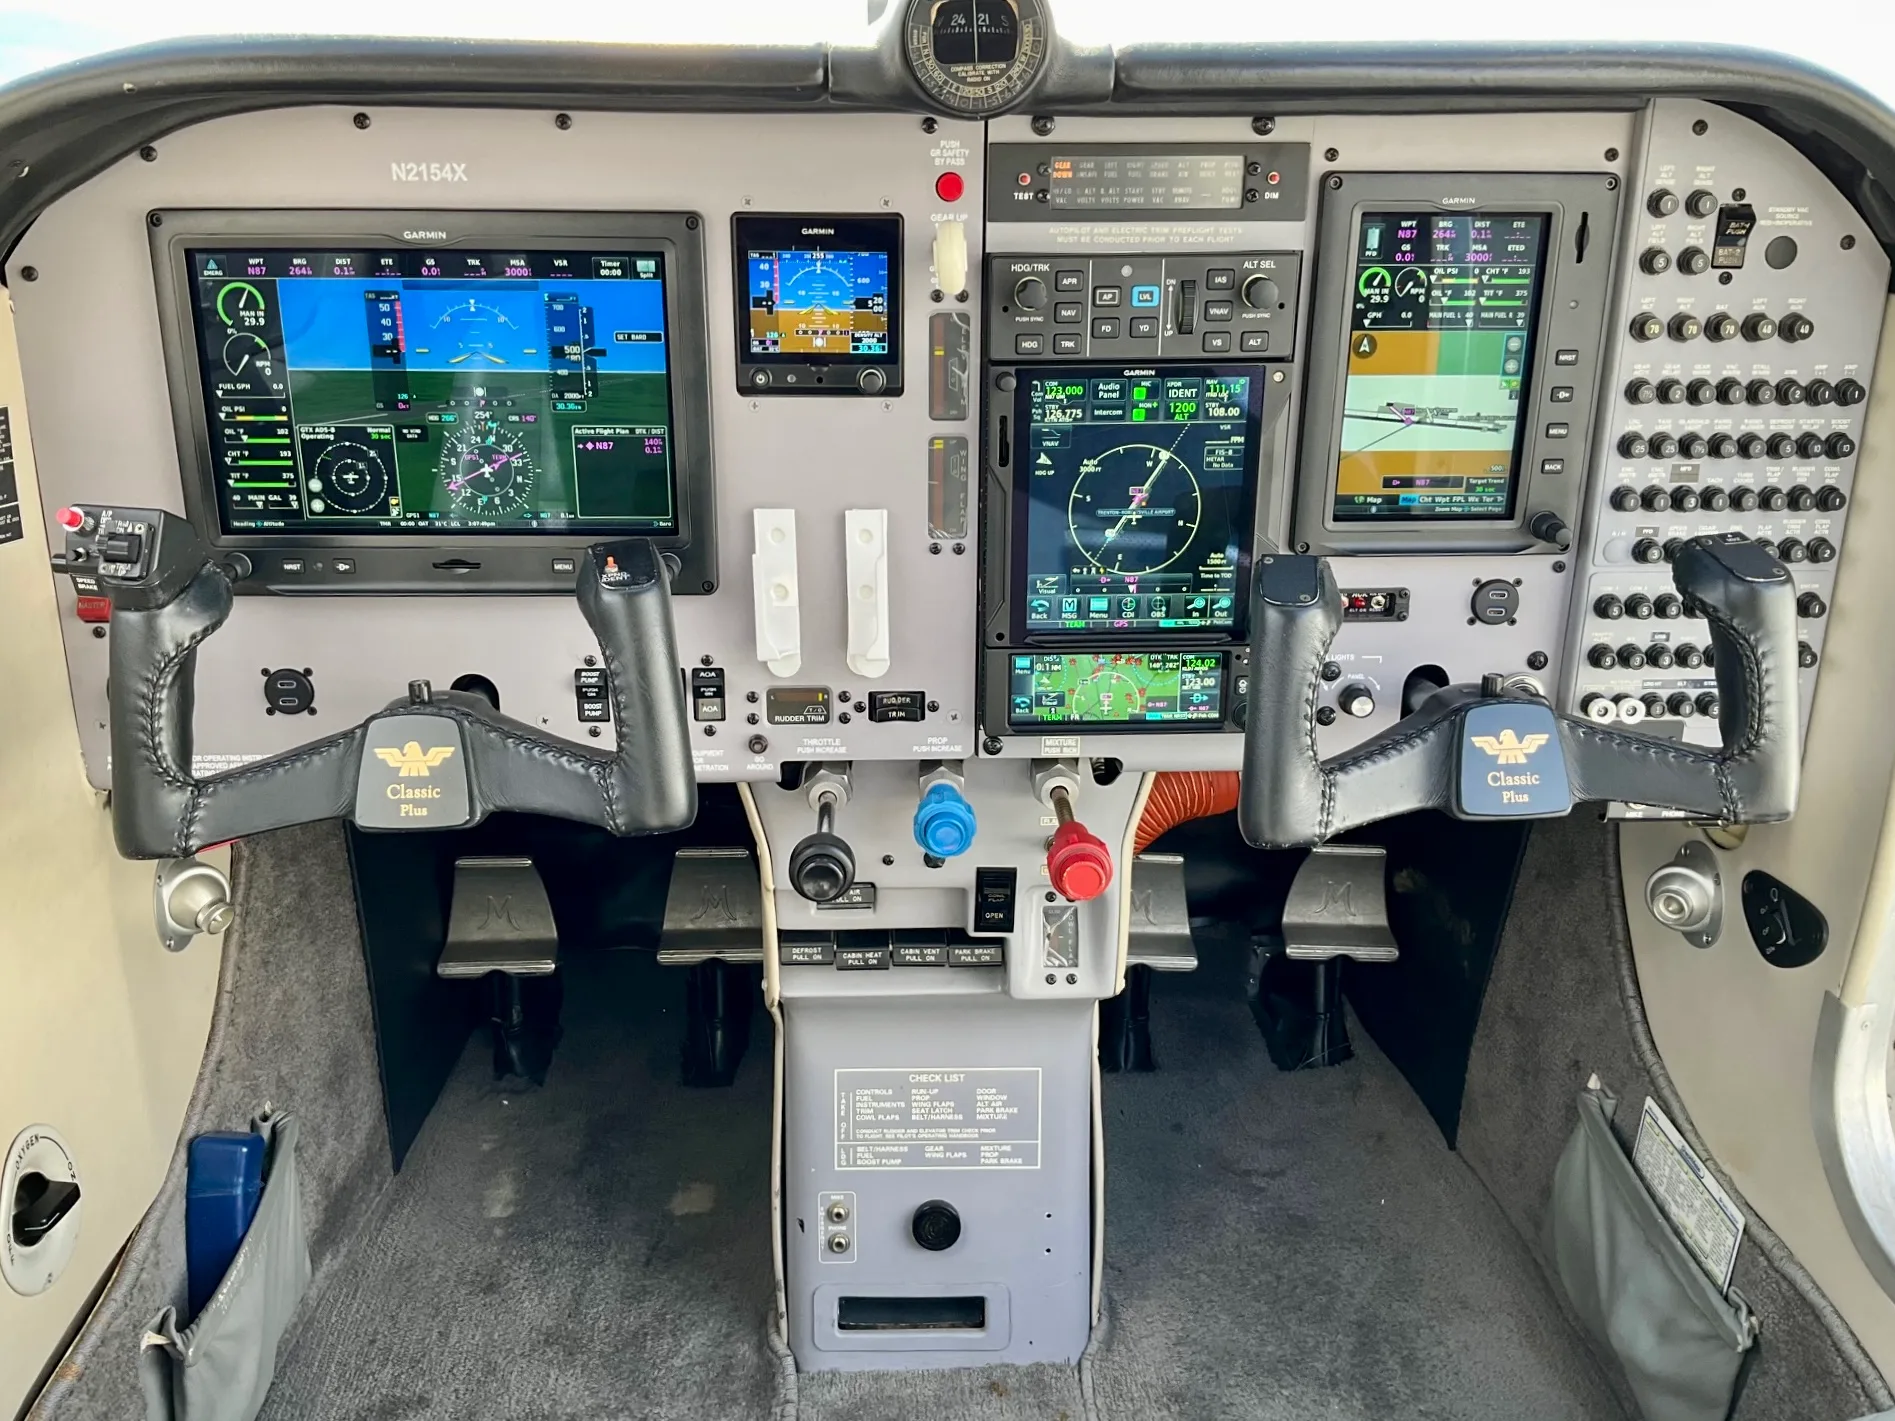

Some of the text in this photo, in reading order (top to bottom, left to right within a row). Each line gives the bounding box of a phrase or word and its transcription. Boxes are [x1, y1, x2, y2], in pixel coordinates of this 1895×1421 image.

[951, 13, 989, 26] 24 21
[939, 139, 961, 149] PUSH
[942, 148, 970, 157] SAFETY
[934, 157, 966, 166] BY PASS
[391, 161, 468, 182] N2154X
[1013, 192, 1279, 200] TEST DIM
[930, 213, 955, 222] GEAR
[403, 230, 447, 239] GARMIN
[1049, 227, 1091, 235] AUTOPILOT
[1093, 227, 1109, 235] AND
[1111, 227, 1148, 235] ELECTRIC
[1151, 227, 1170, 235] TRIM
[1173, 227, 1216, 235] PREFLIGHT
[1398, 230, 1417, 239] N87
[1182, 235, 1201, 243] EACH
[1203, 235, 1235, 243] FLIGHT
[1718, 248, 1740, 256] BAT-2
[601, 260, 621, 268] Timer
[1243, 260, 1276, 269] ALT SEL
[1718, 256, 1738, 264] PUSH
[247, 266, 266, 275] N87
[600, 268, 622, 277] 00:00
[1011, 264, 1050, 272] HDG/TRK
[1062, 277, 1077, 285] APR
[244, 318, 265, 326] 29.9
[1101, 325, 1111, 333] FD
[1139, 324, 1149, 332] YD
[1725, 324, 1734, 334] 70
[1762, 324, 1772, 333] 40
[1800, 324, 1810, 333] 40
[1248, 338, 1262, 346] ALT
[1046, 386, 1083, 396] 123.000
[1098, 382, 1120, 391] Audio
[1098, 390, 1120, 399] Panel
[1169, 389, 1197, 398] IDENT
[1169, 403, 1196, 413] 1200
[1045, 407, 1240, 419] 126.775 108.00
[1174, 413, 1189, 421] ALT
[595, 442, 614, 450] N87
[1366, 496, 1382, 504] Map
[553, 563, 572, 571] MENU
[1184, 677, 1215, 687] 123.00
[1045, 738, 1077, 746] MIXTURE
[1487, 771, 1541, 786] Classic
[386, 784, 441, 799] Classic
[1502, 790, 1529, 804] Plus
[400, 803, 428, 816] Plus
[1662, 810, 1685, 818] PHONE
[690, 885, 737, 921] M
[1314, 880, 1357, 917] M
[1131, 889, 1157, 925] M
[477, 895, 522, 931] M
[909, 1074, 966, 1082] CHECK LIST
[15, 1133, 40, 1170] OXYGEN
[67, 1160, 76, 1182] ON
